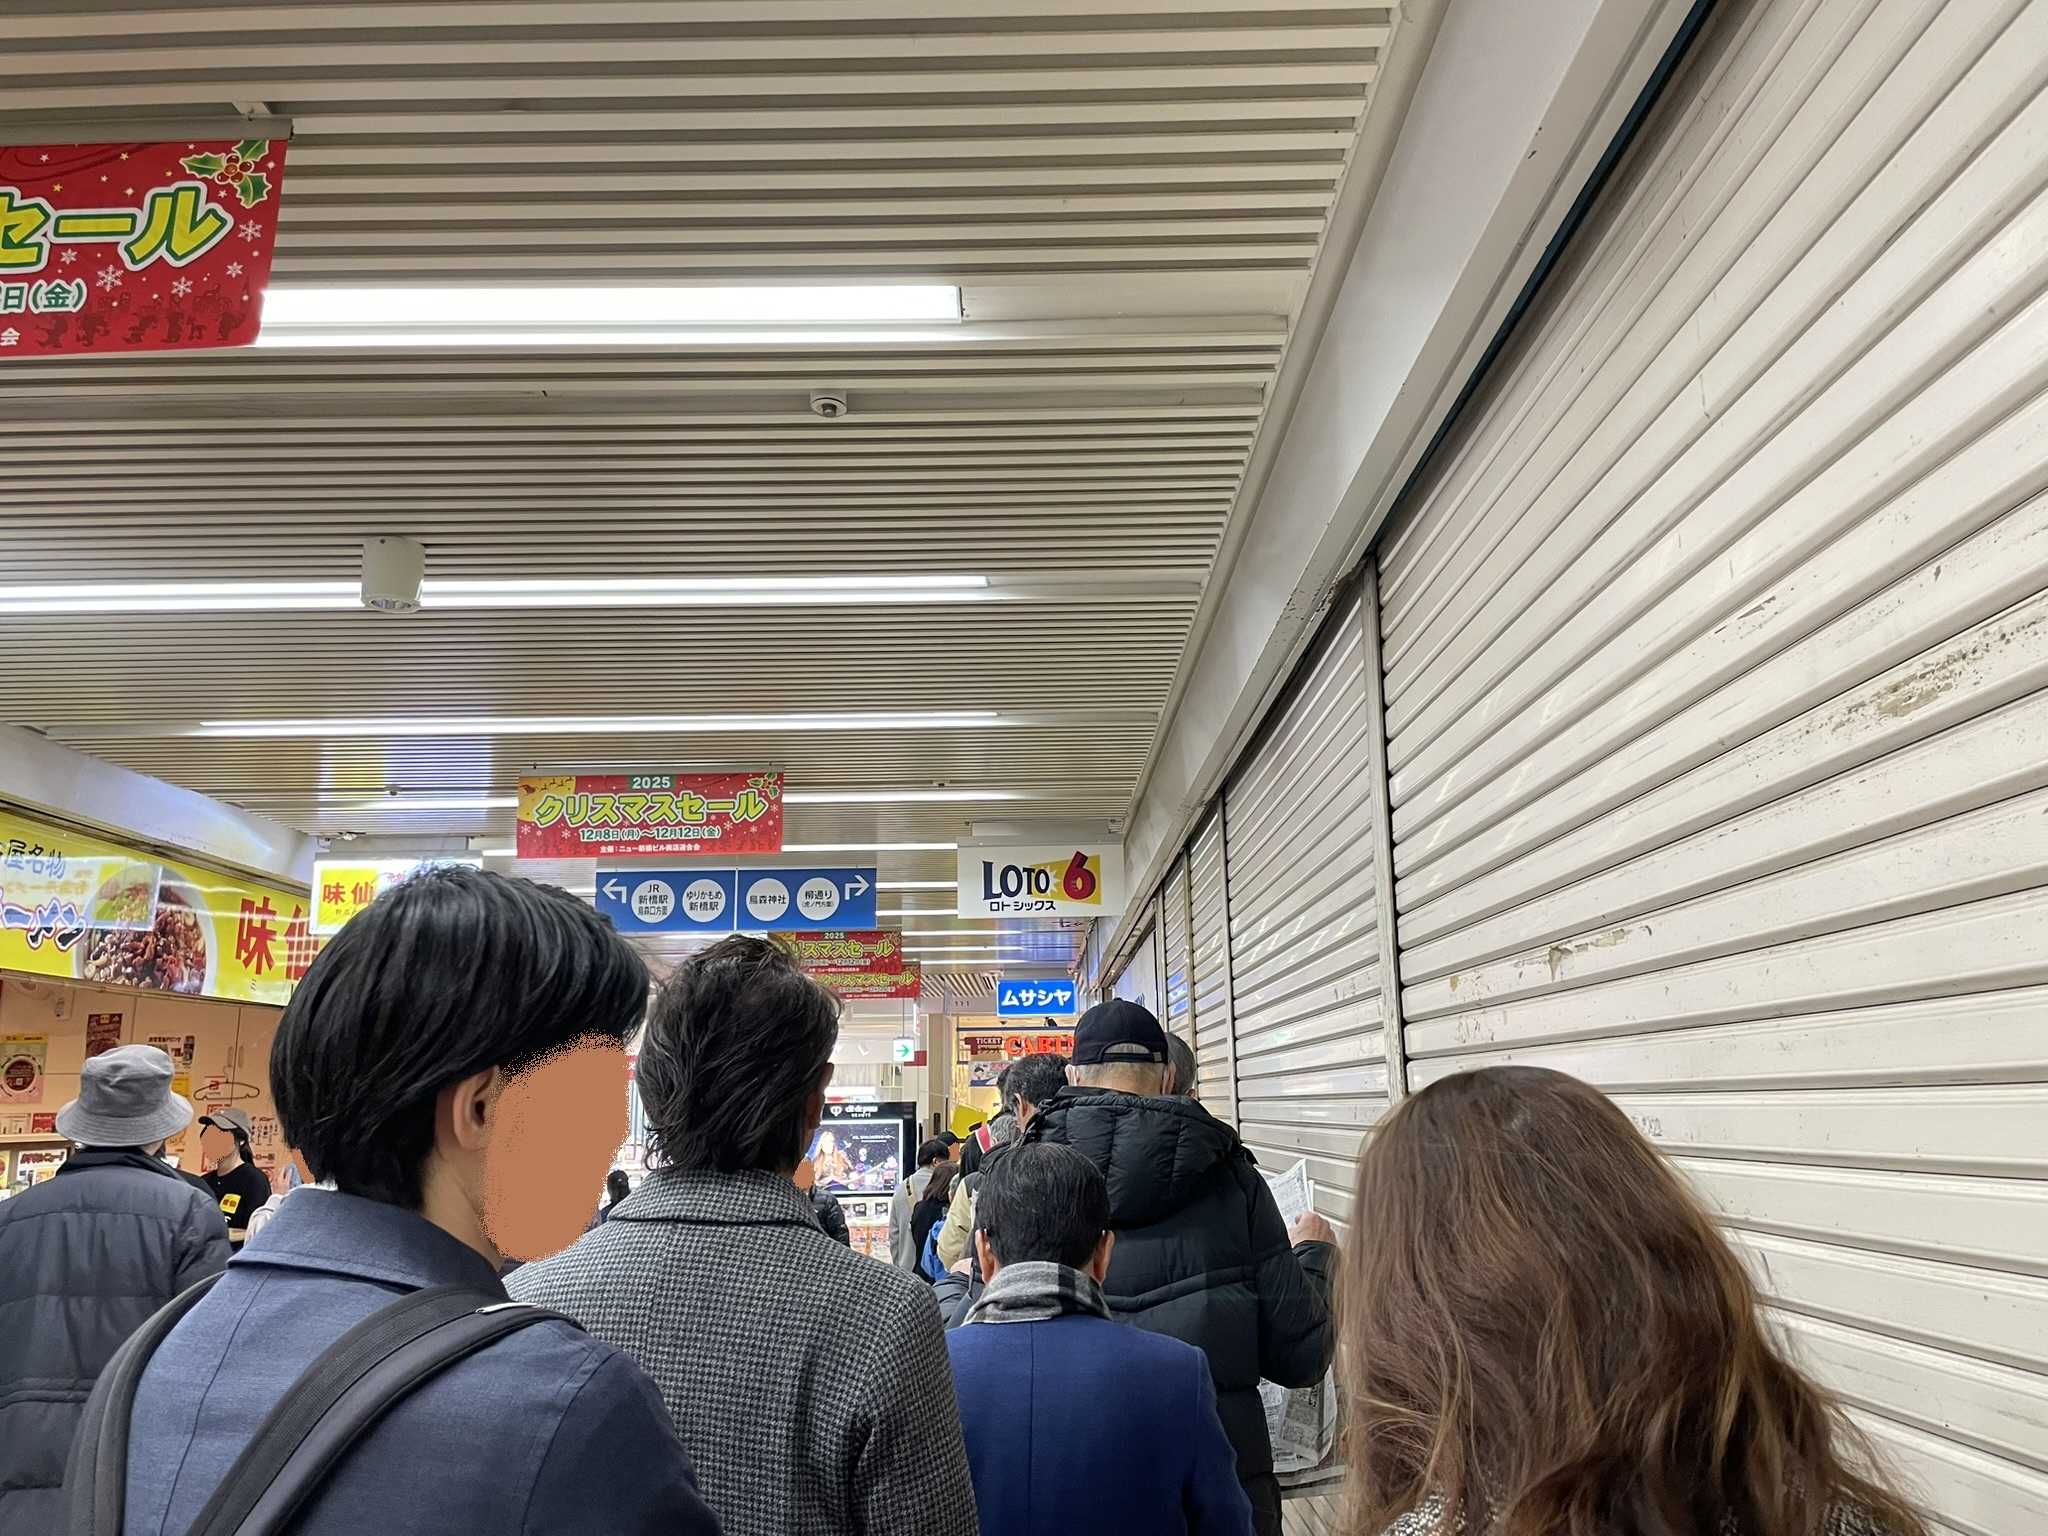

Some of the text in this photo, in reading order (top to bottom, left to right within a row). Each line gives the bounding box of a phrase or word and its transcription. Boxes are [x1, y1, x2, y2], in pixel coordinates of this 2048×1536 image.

[632, 776, 671, 789] 2025
[535, 790, 767, 826] クリスマスセール
[0, 839, 67, 879] 屋名物
[982, 850, 1097, 900] LOTO 6
[322, 881, 375, 905] 味仙
[647, 884, 660, 893] JR
[804, 890, 833, 900] 柳通り
[638, 895, 668, 905] 新橋駅
[686, 891, 723, 900] ゆりかもめ
[689, 902, 719, 912] 新橋駅
[824, 932, 845, 940] 2025
[786, 940, 894, 958] リスマスセール
[820, 970, 916, 986] クリスマスセール
[1001, 989, 1072, 1007] ムサシヤ
[976, 1037, 1002, 1045] TICKET
